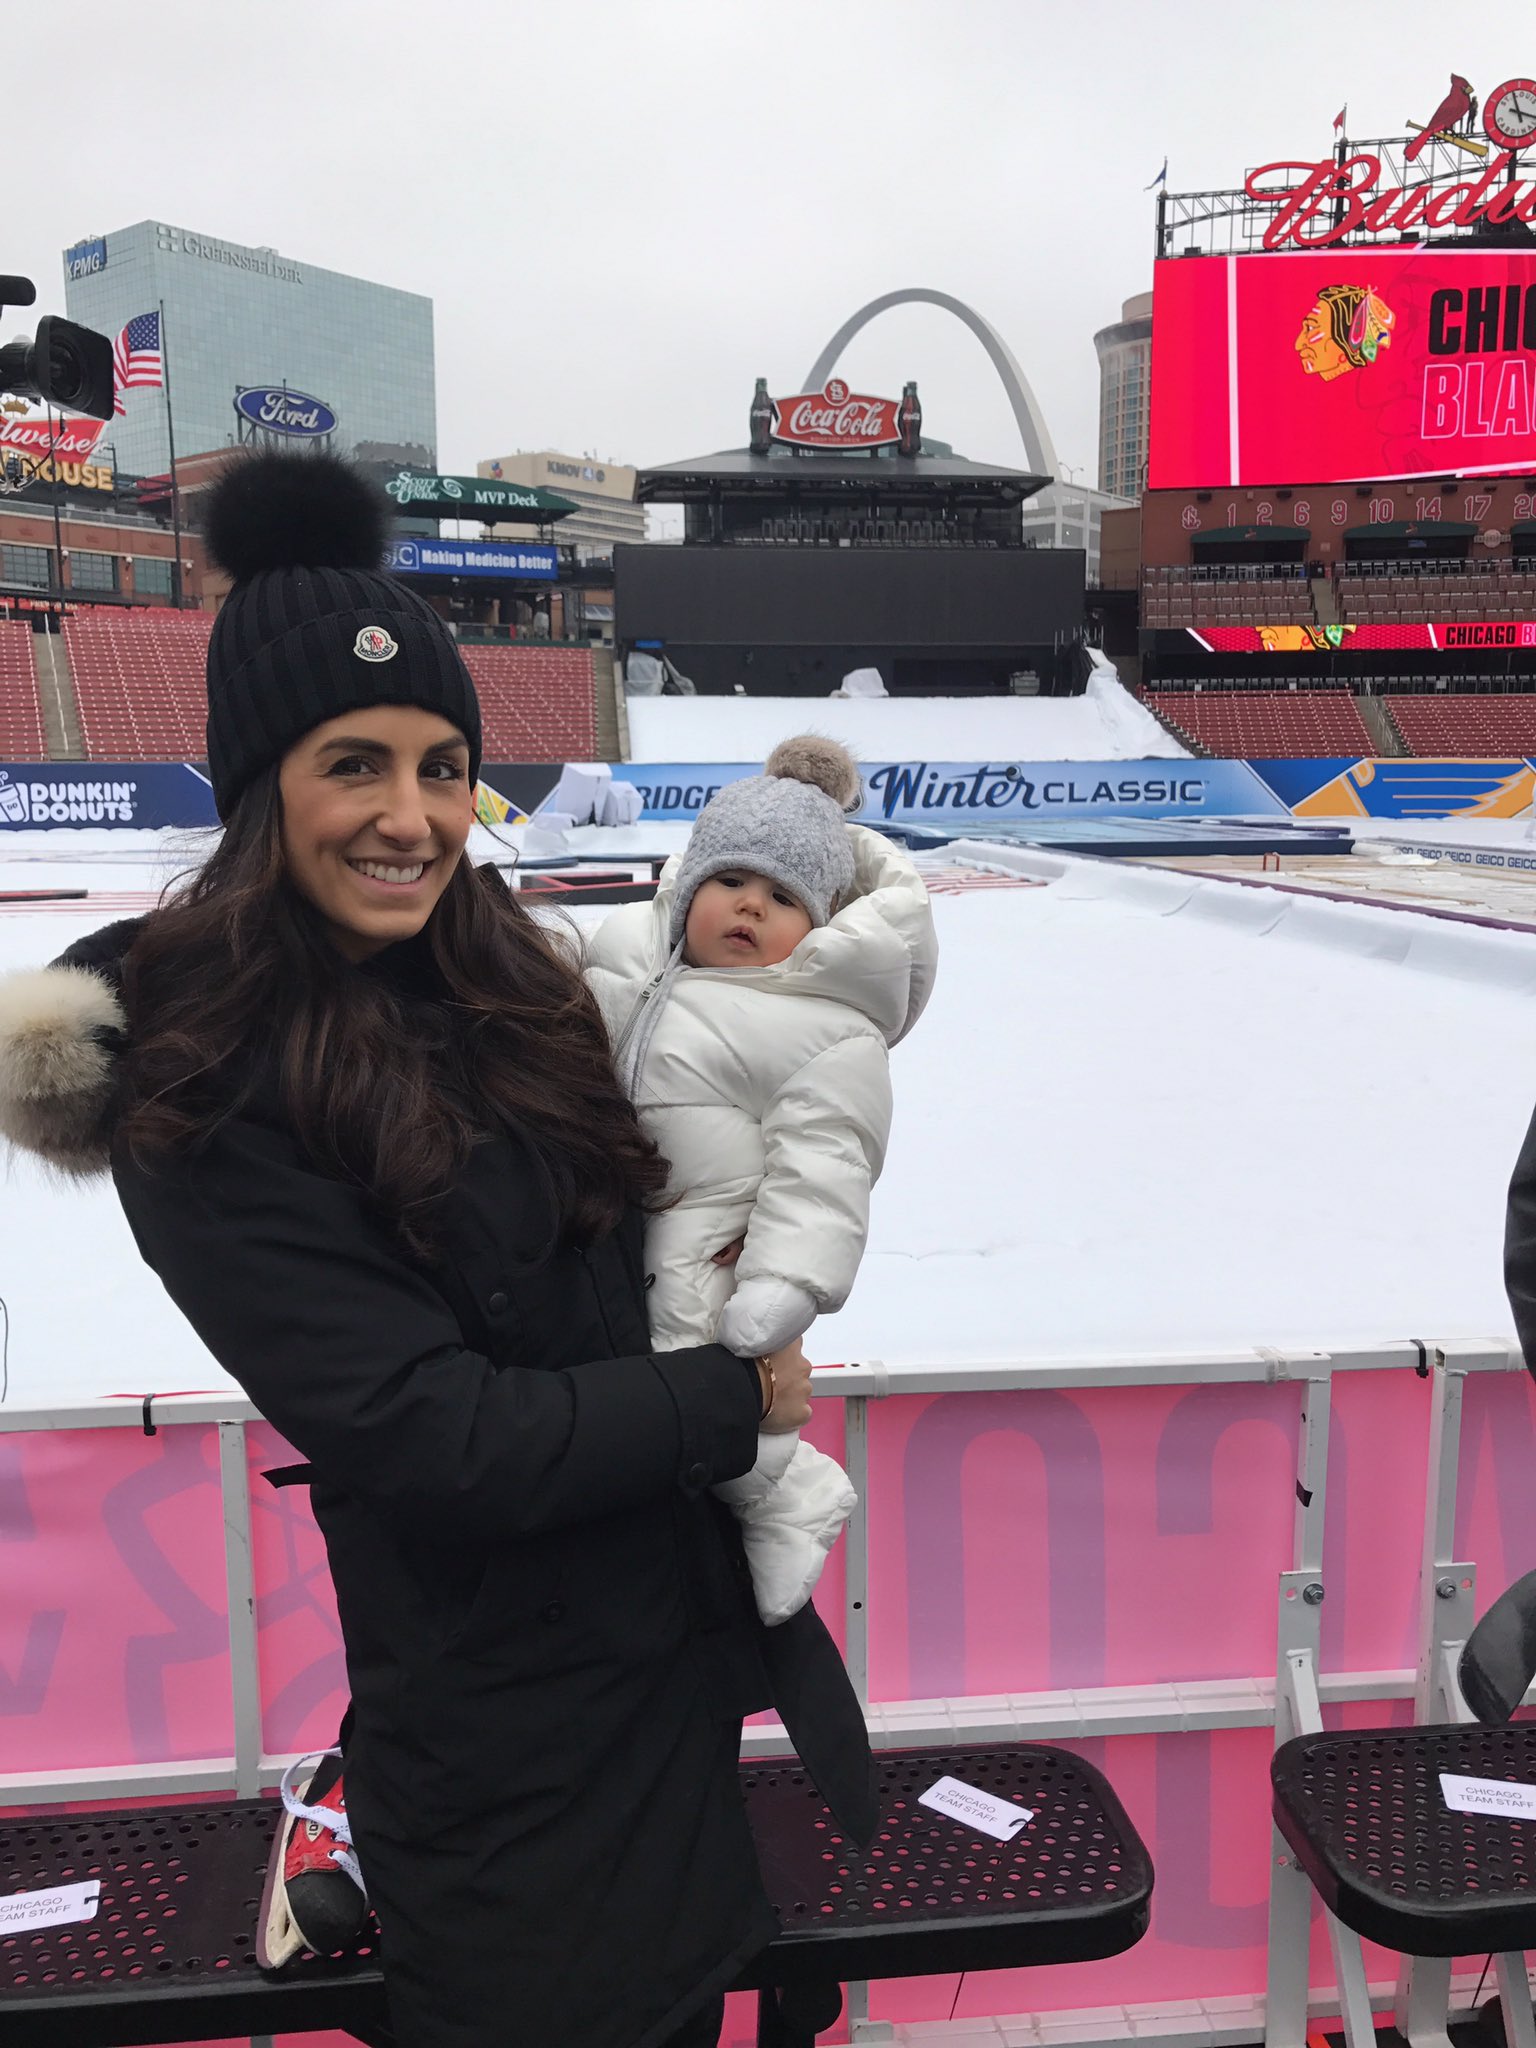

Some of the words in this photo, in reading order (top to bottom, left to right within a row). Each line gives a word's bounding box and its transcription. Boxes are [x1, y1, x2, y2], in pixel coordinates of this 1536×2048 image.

[66, 252, 101, 281] KPMG
[1421, 360, 1536, 439] BLA
[259, 392, 319, 429] Ford
[790, 401, 885, 436] Coca-Cola
[547, 460, 580, 478] KMOV
[475, 490, 506, 504] MVP
[508, 493, 539, 507] Deck
[1227, 503, 1236, 528] 1
[1256, 502, 1273, 526] 2
[1293, 501, 1310, 526] 6
[1331, 500, 1348, 525] 9
[1369, 498, 1394, 524] 10
[1416, 496, 1442, 521] 14
[1464, 495, 1492, 521] 17
[421, 550, 464, 567] Making
[465, 552, 517, 569] Medicine
[518, 554, 553, 570] Better
[1446, 625, 1517, 646] CHICAGO
[360, 644, 392, 657] MONCLER
[30, 782, 137, 802] DUNKIN'
[869, 763, 1041, 818] Winter
[1043, 780, 1205, 805] CLASSIC
[31, 801, 134, 822] DONUTS
[1475, 853, 1505, 867] GEICO
[947, 1789, 996, 1813] CHICAGO
[1459, 1794, 1493, 1804] TEAM
[1496, 1798, 1534, 1808] STAFF
[1465, 1786, 1522, 1799] CHICAGO
[934, 1791, 961, 1809] TEAM
[963, 1805, 998, 1823] STAFF
[0, 1896, 63, 1913] CHICAGO
[29, 1903, 72, 1918] STAFF
